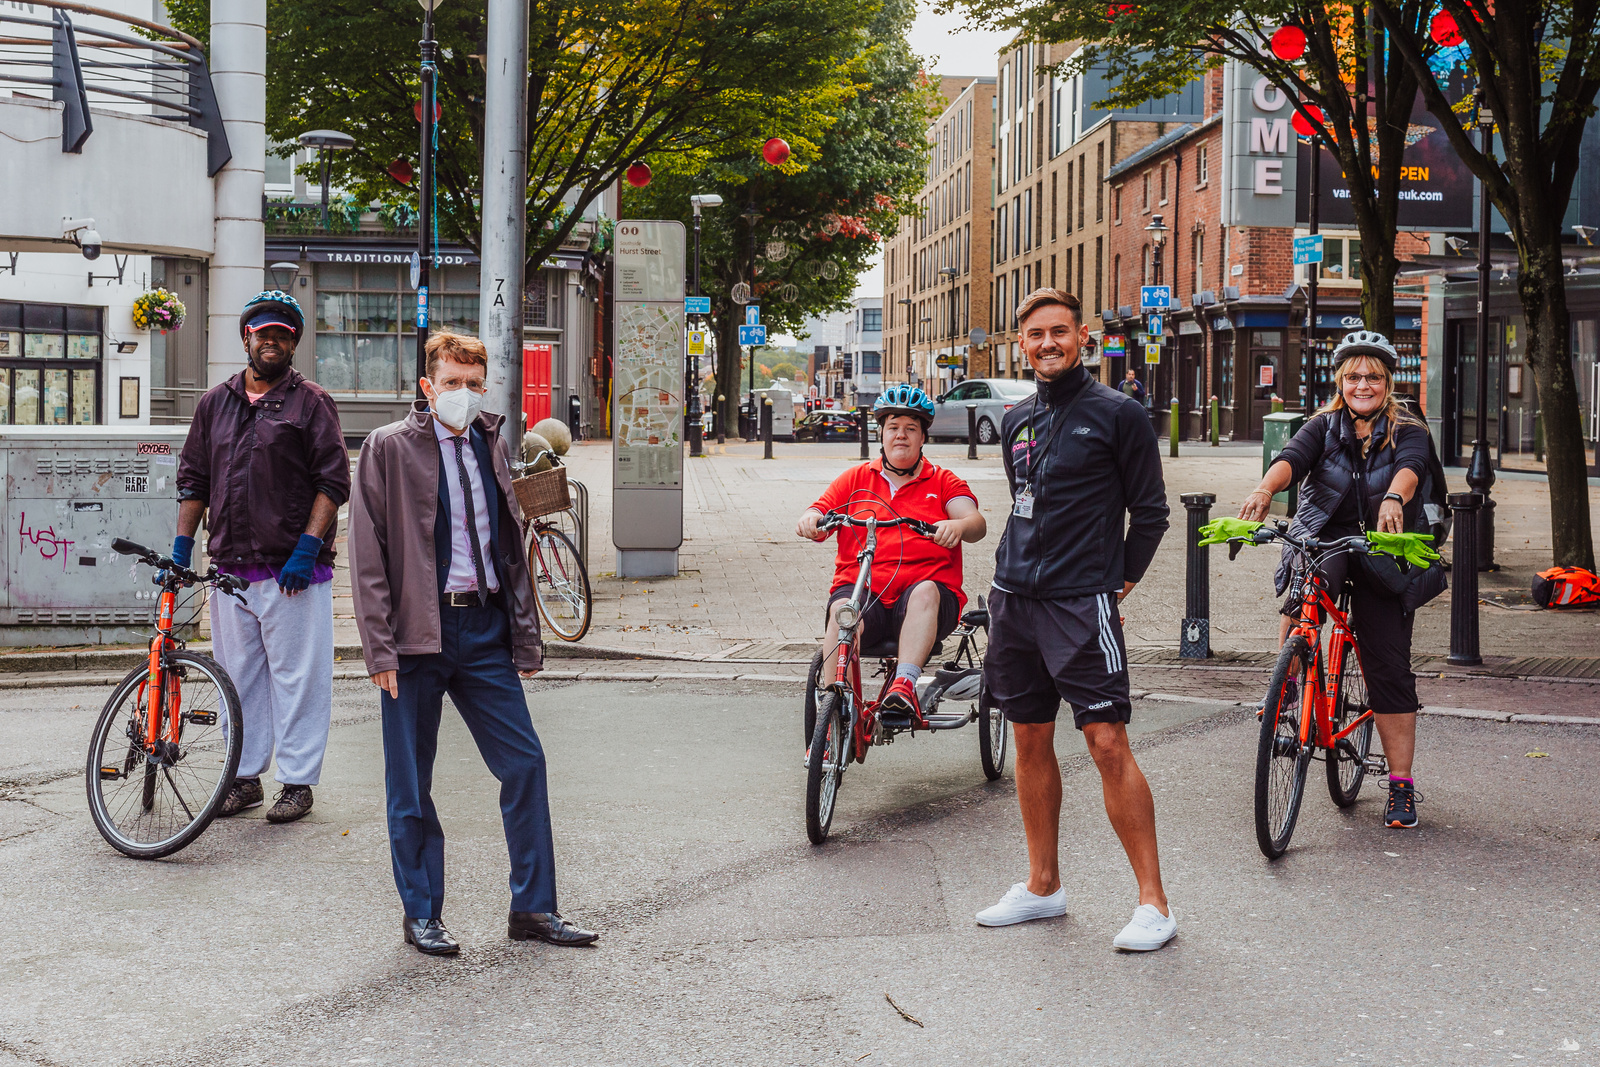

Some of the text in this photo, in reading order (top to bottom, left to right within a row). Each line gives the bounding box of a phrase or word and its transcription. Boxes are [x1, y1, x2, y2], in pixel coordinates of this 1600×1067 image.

[1399, 165, 1430, 181] PEN
[327, 253, 463, 264] TRADITIONA OOD
[494, 278, 505, 292] 7
[494, 294, 505, 306] A
[138, 443, 170, 454] VOYDER
[1088, 700, 1113, 710] adidas
